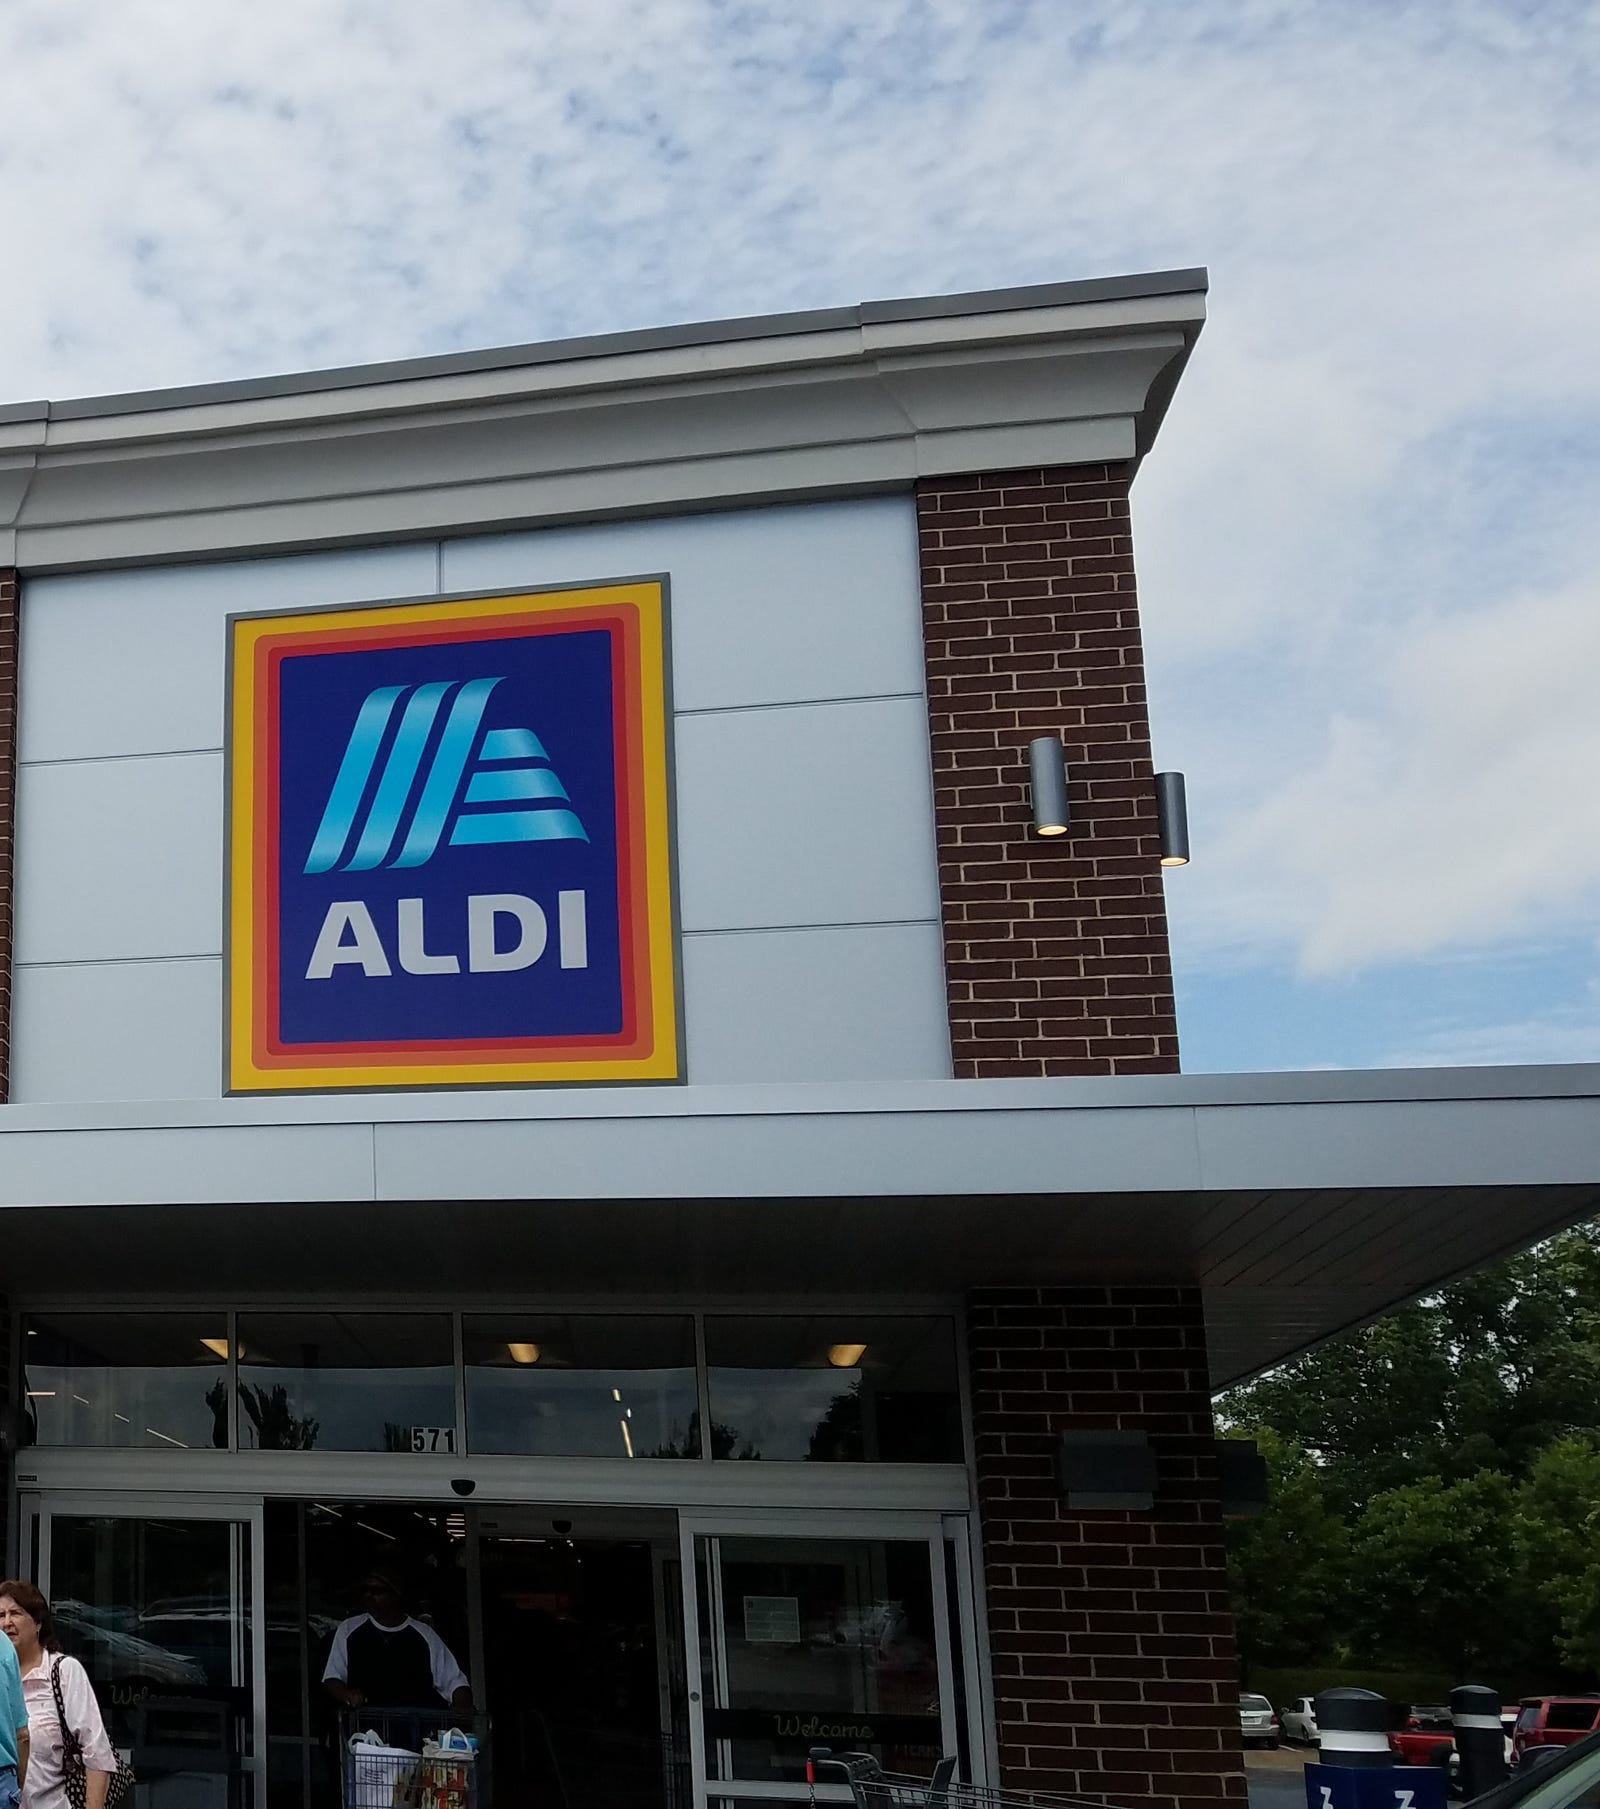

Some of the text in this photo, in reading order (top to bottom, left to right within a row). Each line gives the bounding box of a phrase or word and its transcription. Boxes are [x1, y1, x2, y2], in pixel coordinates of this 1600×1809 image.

[304, 889, 590, 981] ALDI
[413, 1428, 455, 1452] 571
[772, 1713, 875, 1738] Welcome
